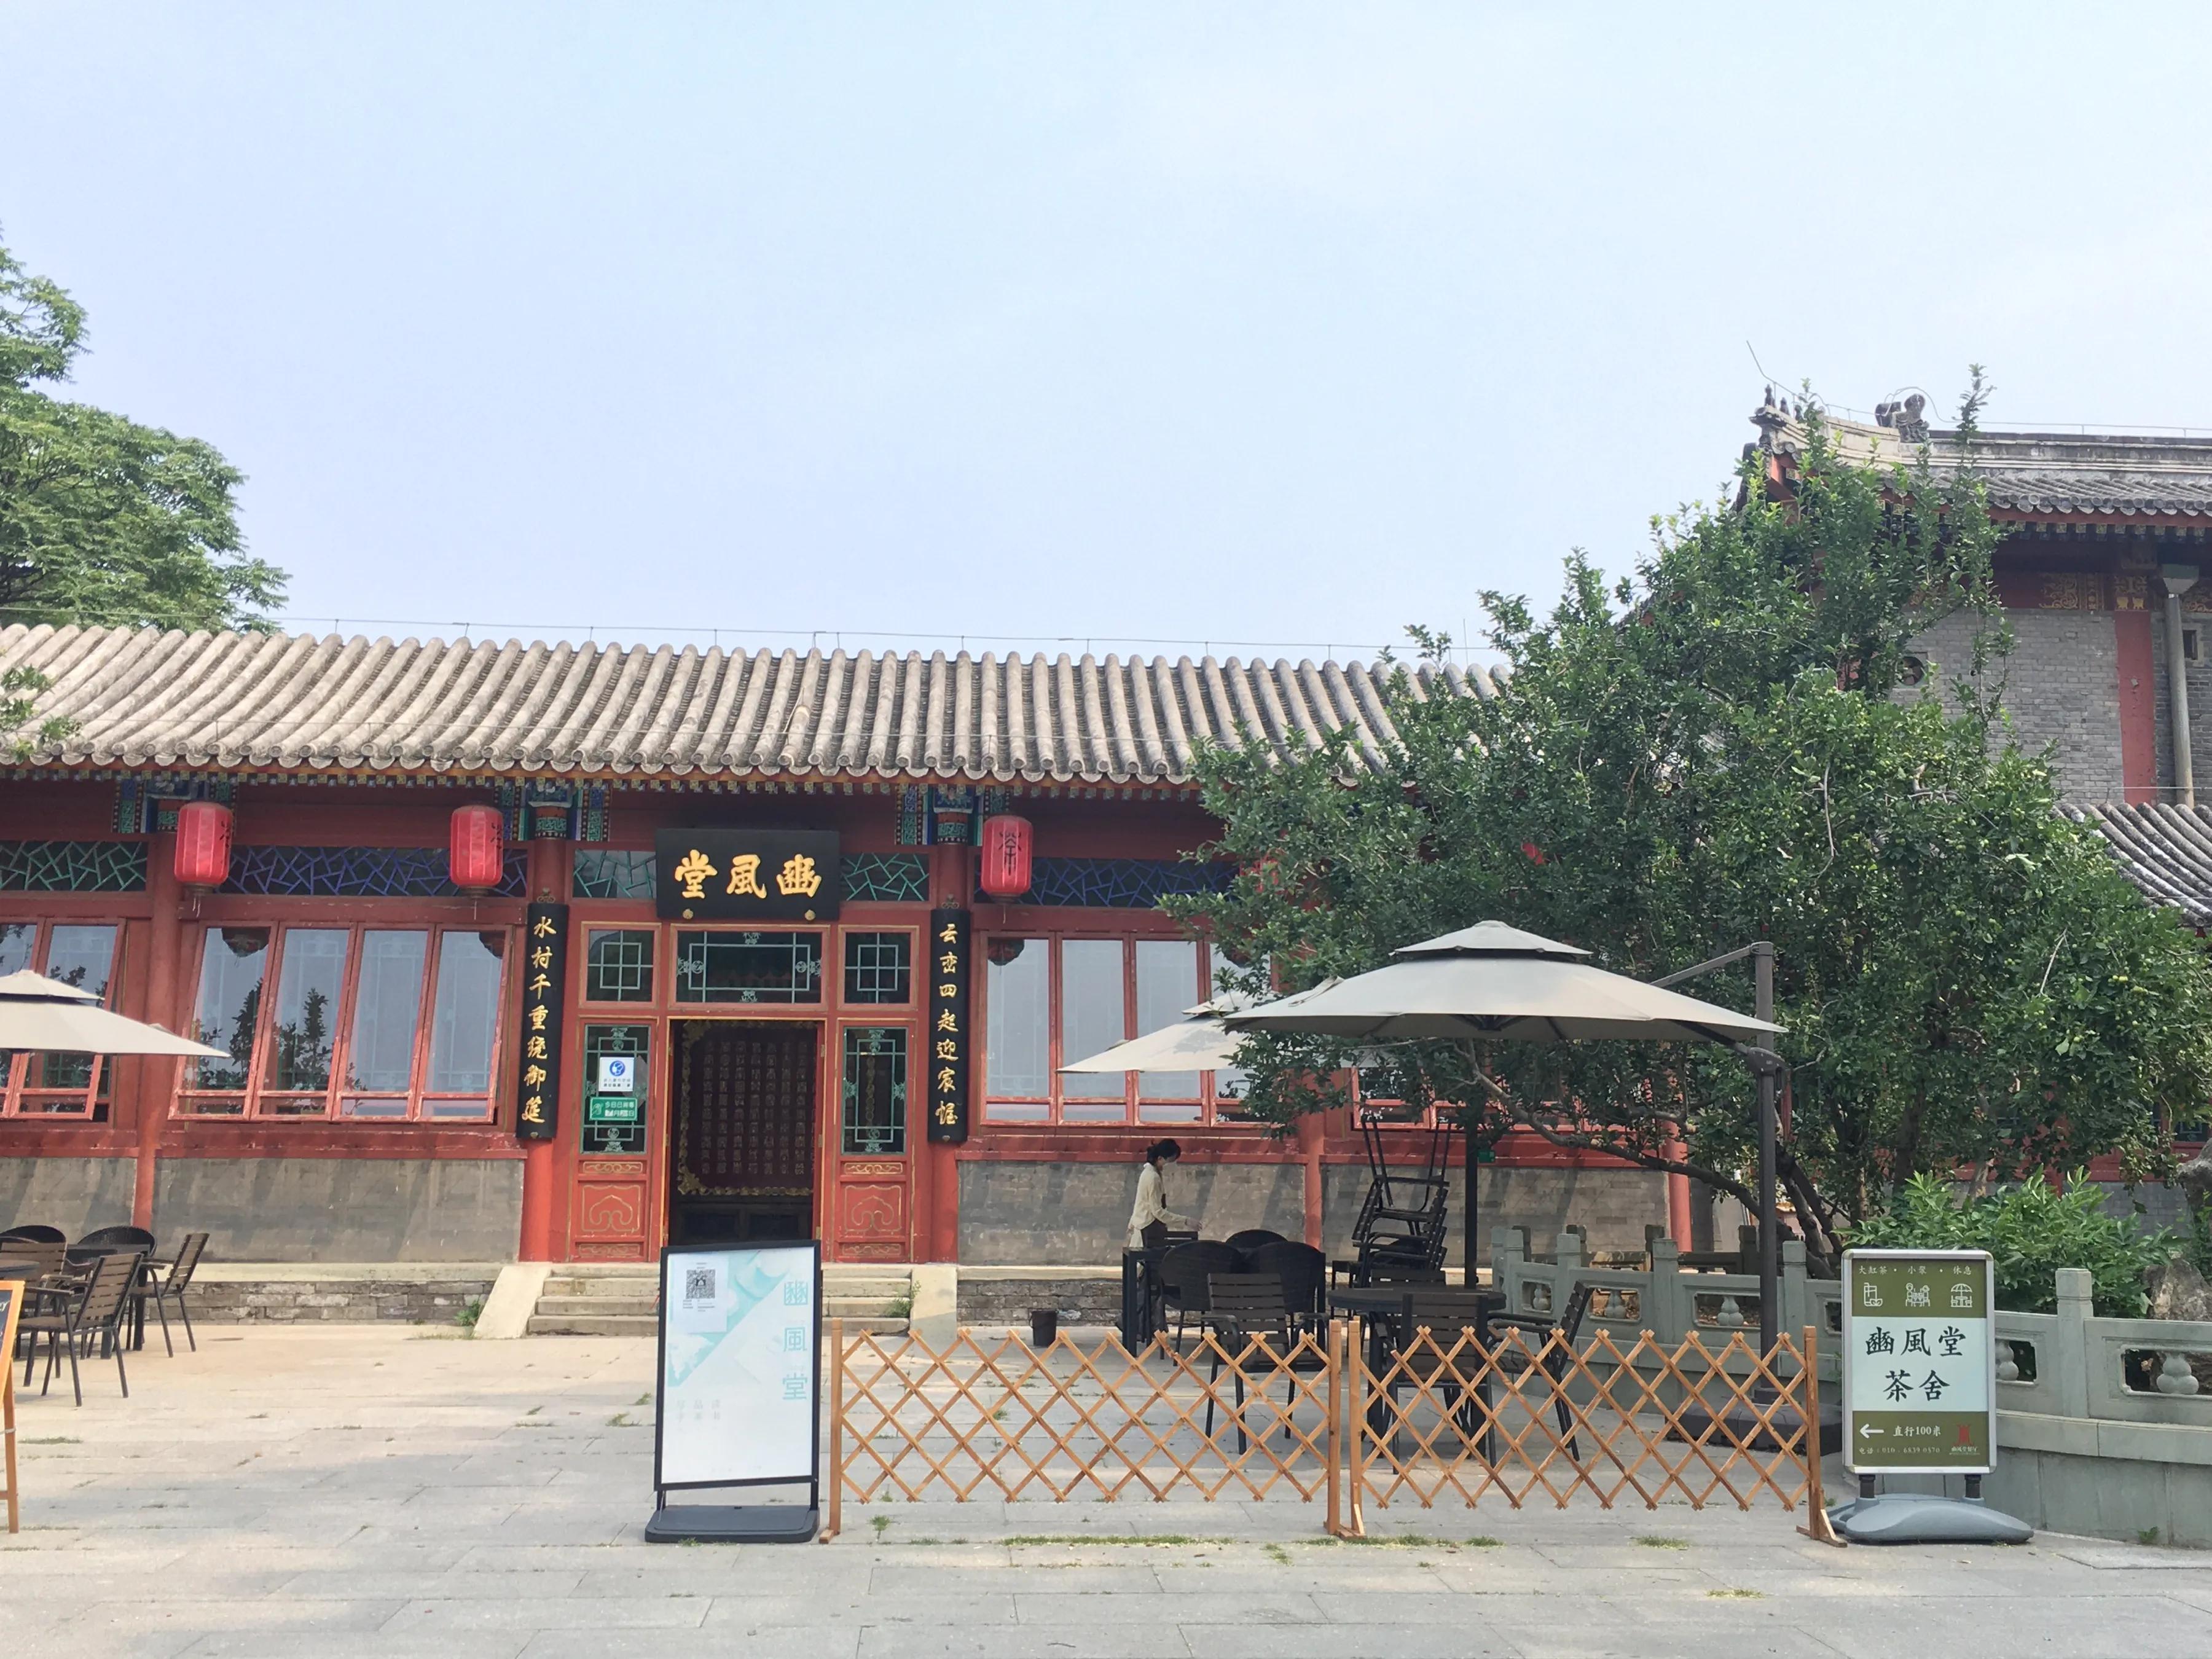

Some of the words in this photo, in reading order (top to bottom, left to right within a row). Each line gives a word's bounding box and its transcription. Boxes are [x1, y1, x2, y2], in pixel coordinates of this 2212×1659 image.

[1953, 1265, 1972, 1276] 休息
[1883, 1369, 1950, 1403] 茶舍
[1893, 1425, 1942, 1437] 直行100米
